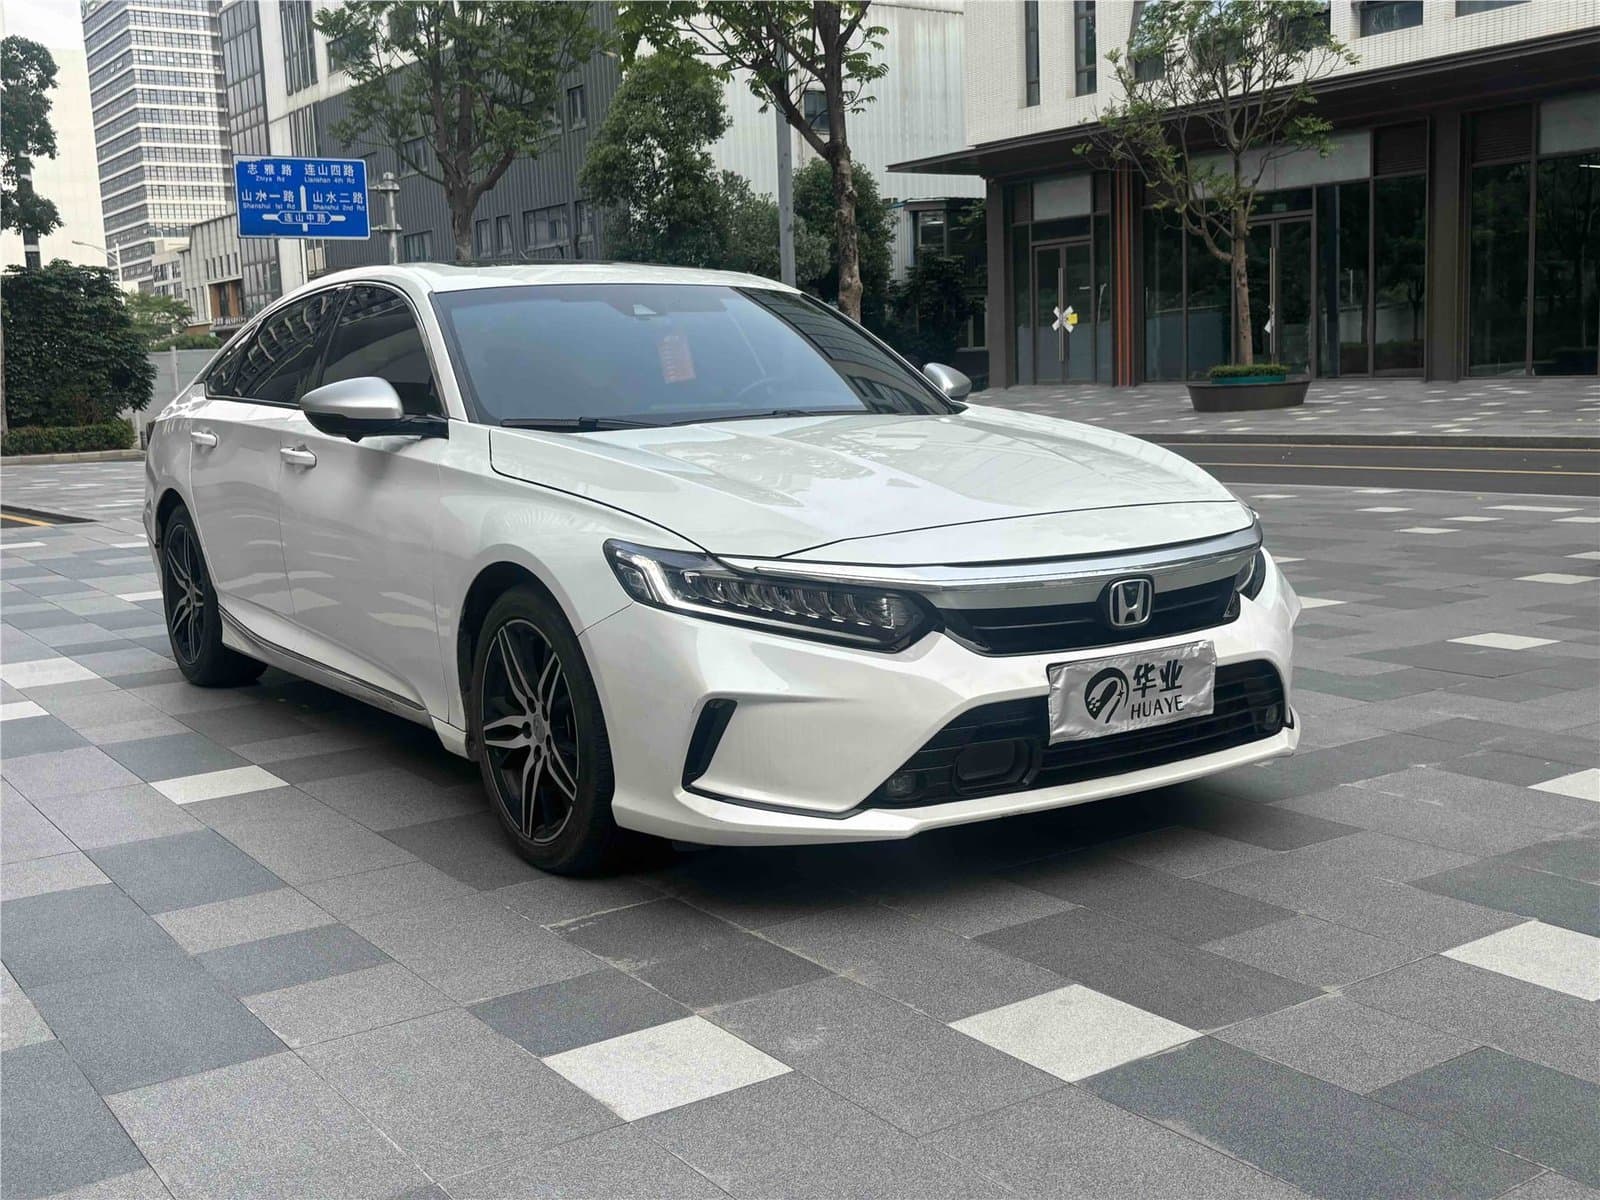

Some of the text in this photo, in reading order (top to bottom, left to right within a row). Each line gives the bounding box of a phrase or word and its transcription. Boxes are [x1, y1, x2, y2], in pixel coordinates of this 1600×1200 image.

[247, 163, 292, 176] 志雅路
[304, 164, 354, 177] 连山四路
[276, 175, 285, 183] Rd
[304, 176, 331, 184] Lianshan
[346, 177, 356, 185] Rd
[241, 188, 295, 203] 山水一路
[312, 191, 363, 204] 山水二路
[313, 203, 340, 211] Shanshui
[284, 213, 326, 223] 连山中路
[1132, 659, 1184, 698] 华业
[1130, 694, 1185, 720] HUAYE
